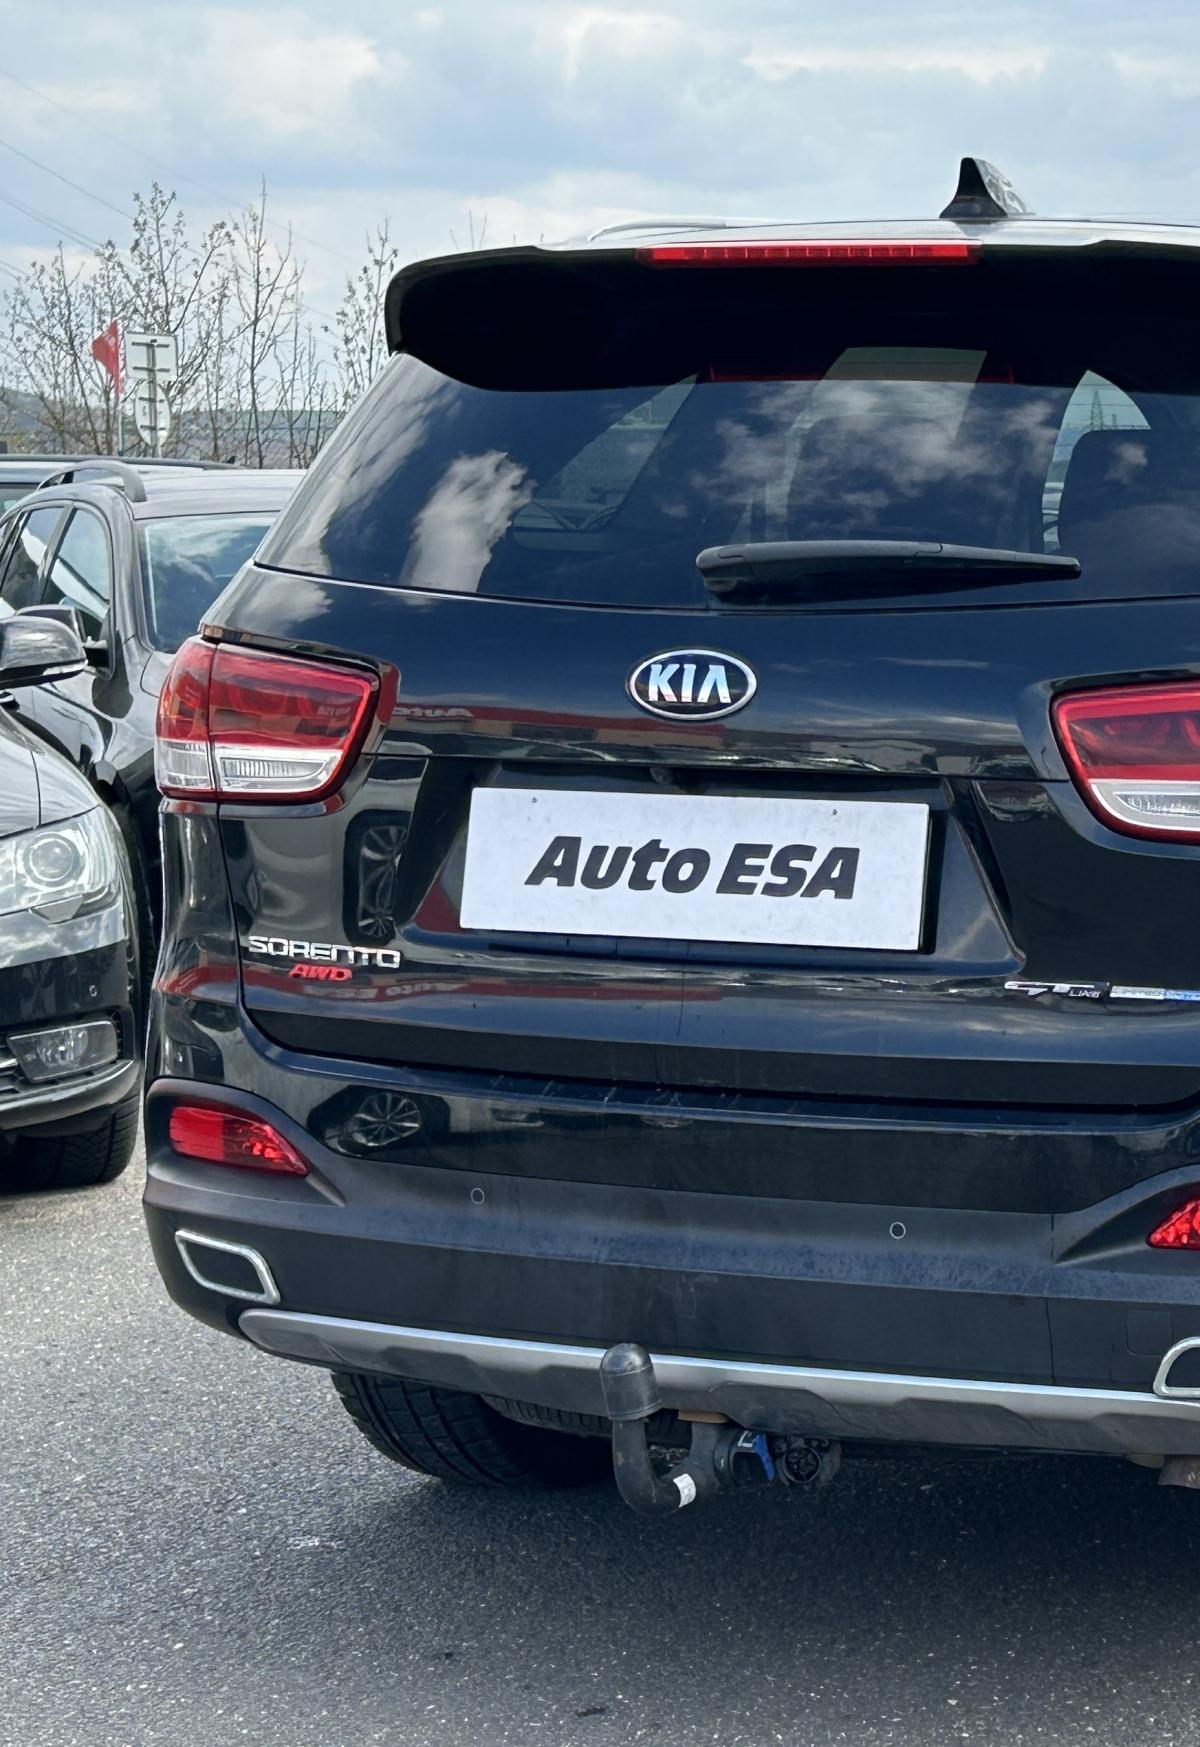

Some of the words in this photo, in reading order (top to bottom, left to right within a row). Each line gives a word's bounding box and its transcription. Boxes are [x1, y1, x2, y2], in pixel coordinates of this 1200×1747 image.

[648, 663, 732, 704] KIA
[524, 835, 711, 894] Auto
[716, 842, 860, 900] ESA
[248, 935, 401, 969] SORENTO
[288, 963, 353, 982] AWD
